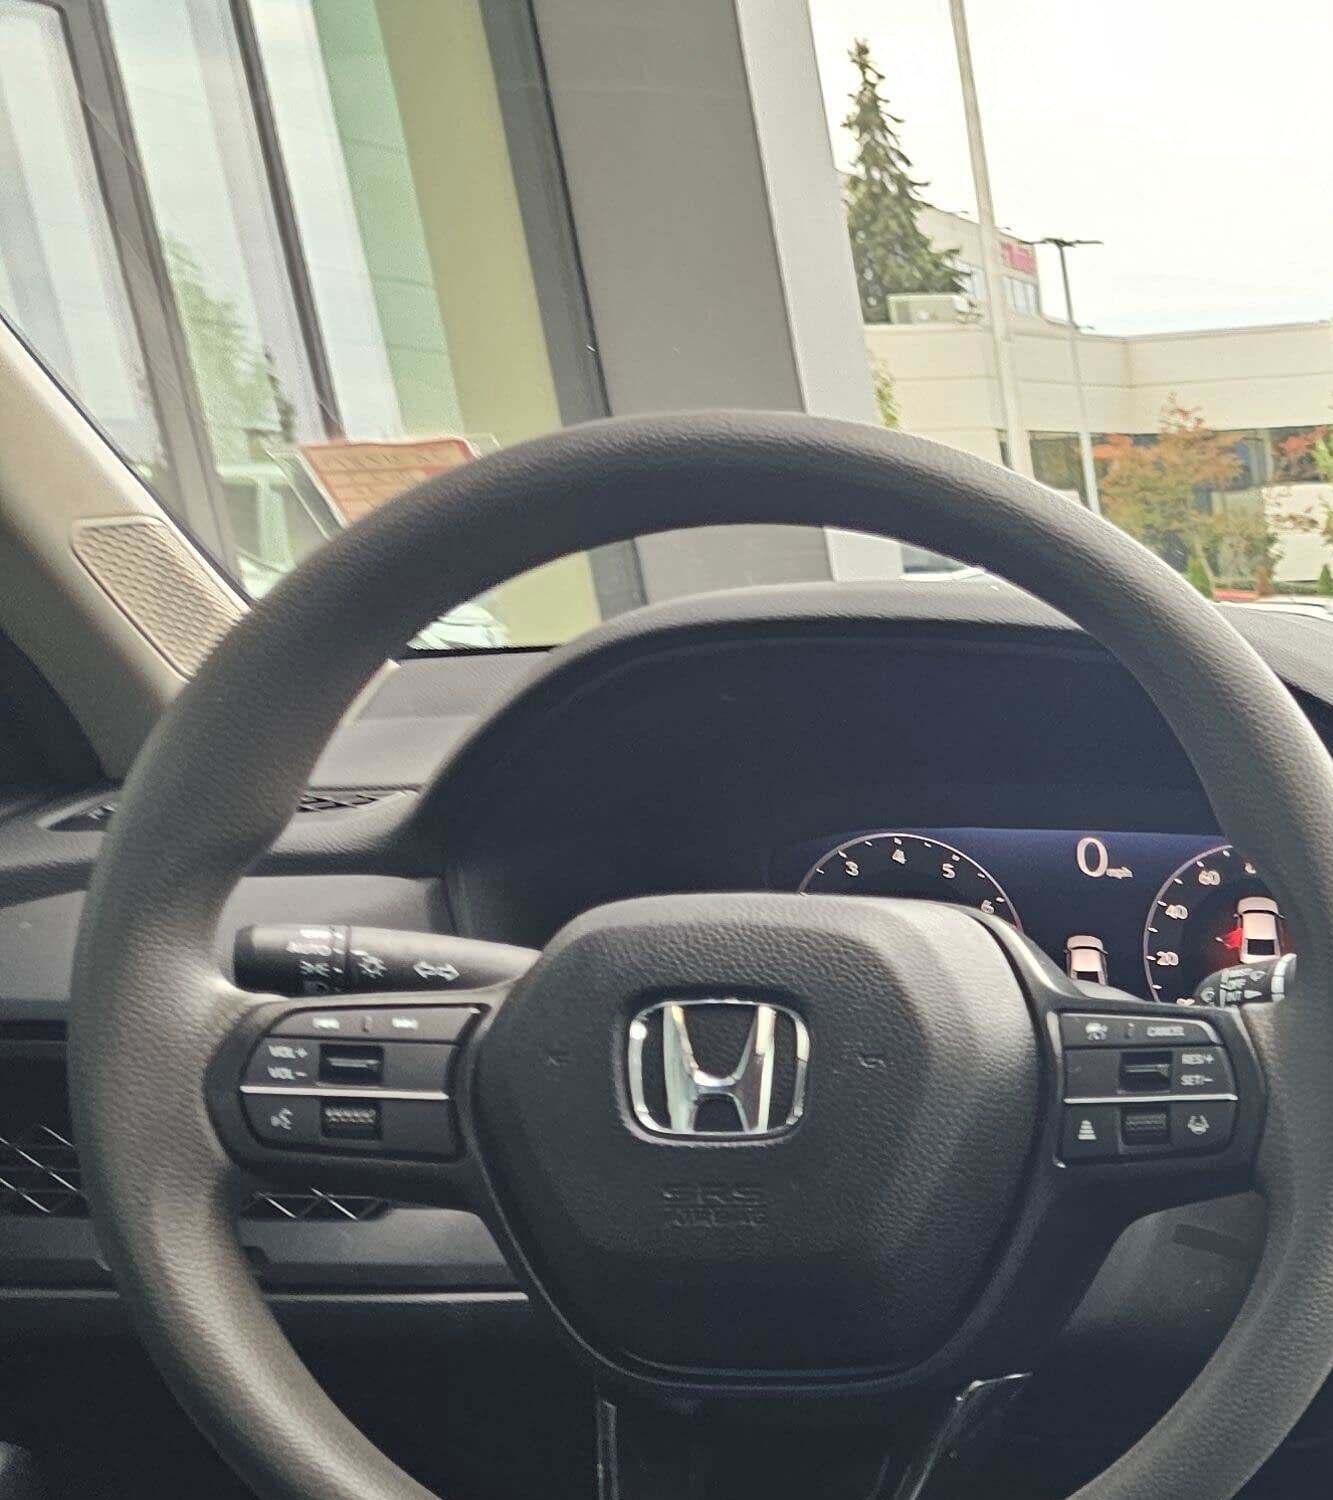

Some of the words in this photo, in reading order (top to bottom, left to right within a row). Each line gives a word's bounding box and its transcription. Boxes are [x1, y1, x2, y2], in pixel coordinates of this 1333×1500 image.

[891, 849, 907, 865] 4
[1076, 836, 1109, 878] 0
[845, 860, 859, 877] 3
[942, 862, 956, 879] 5
[1156, 950, 1179, 966] 20
